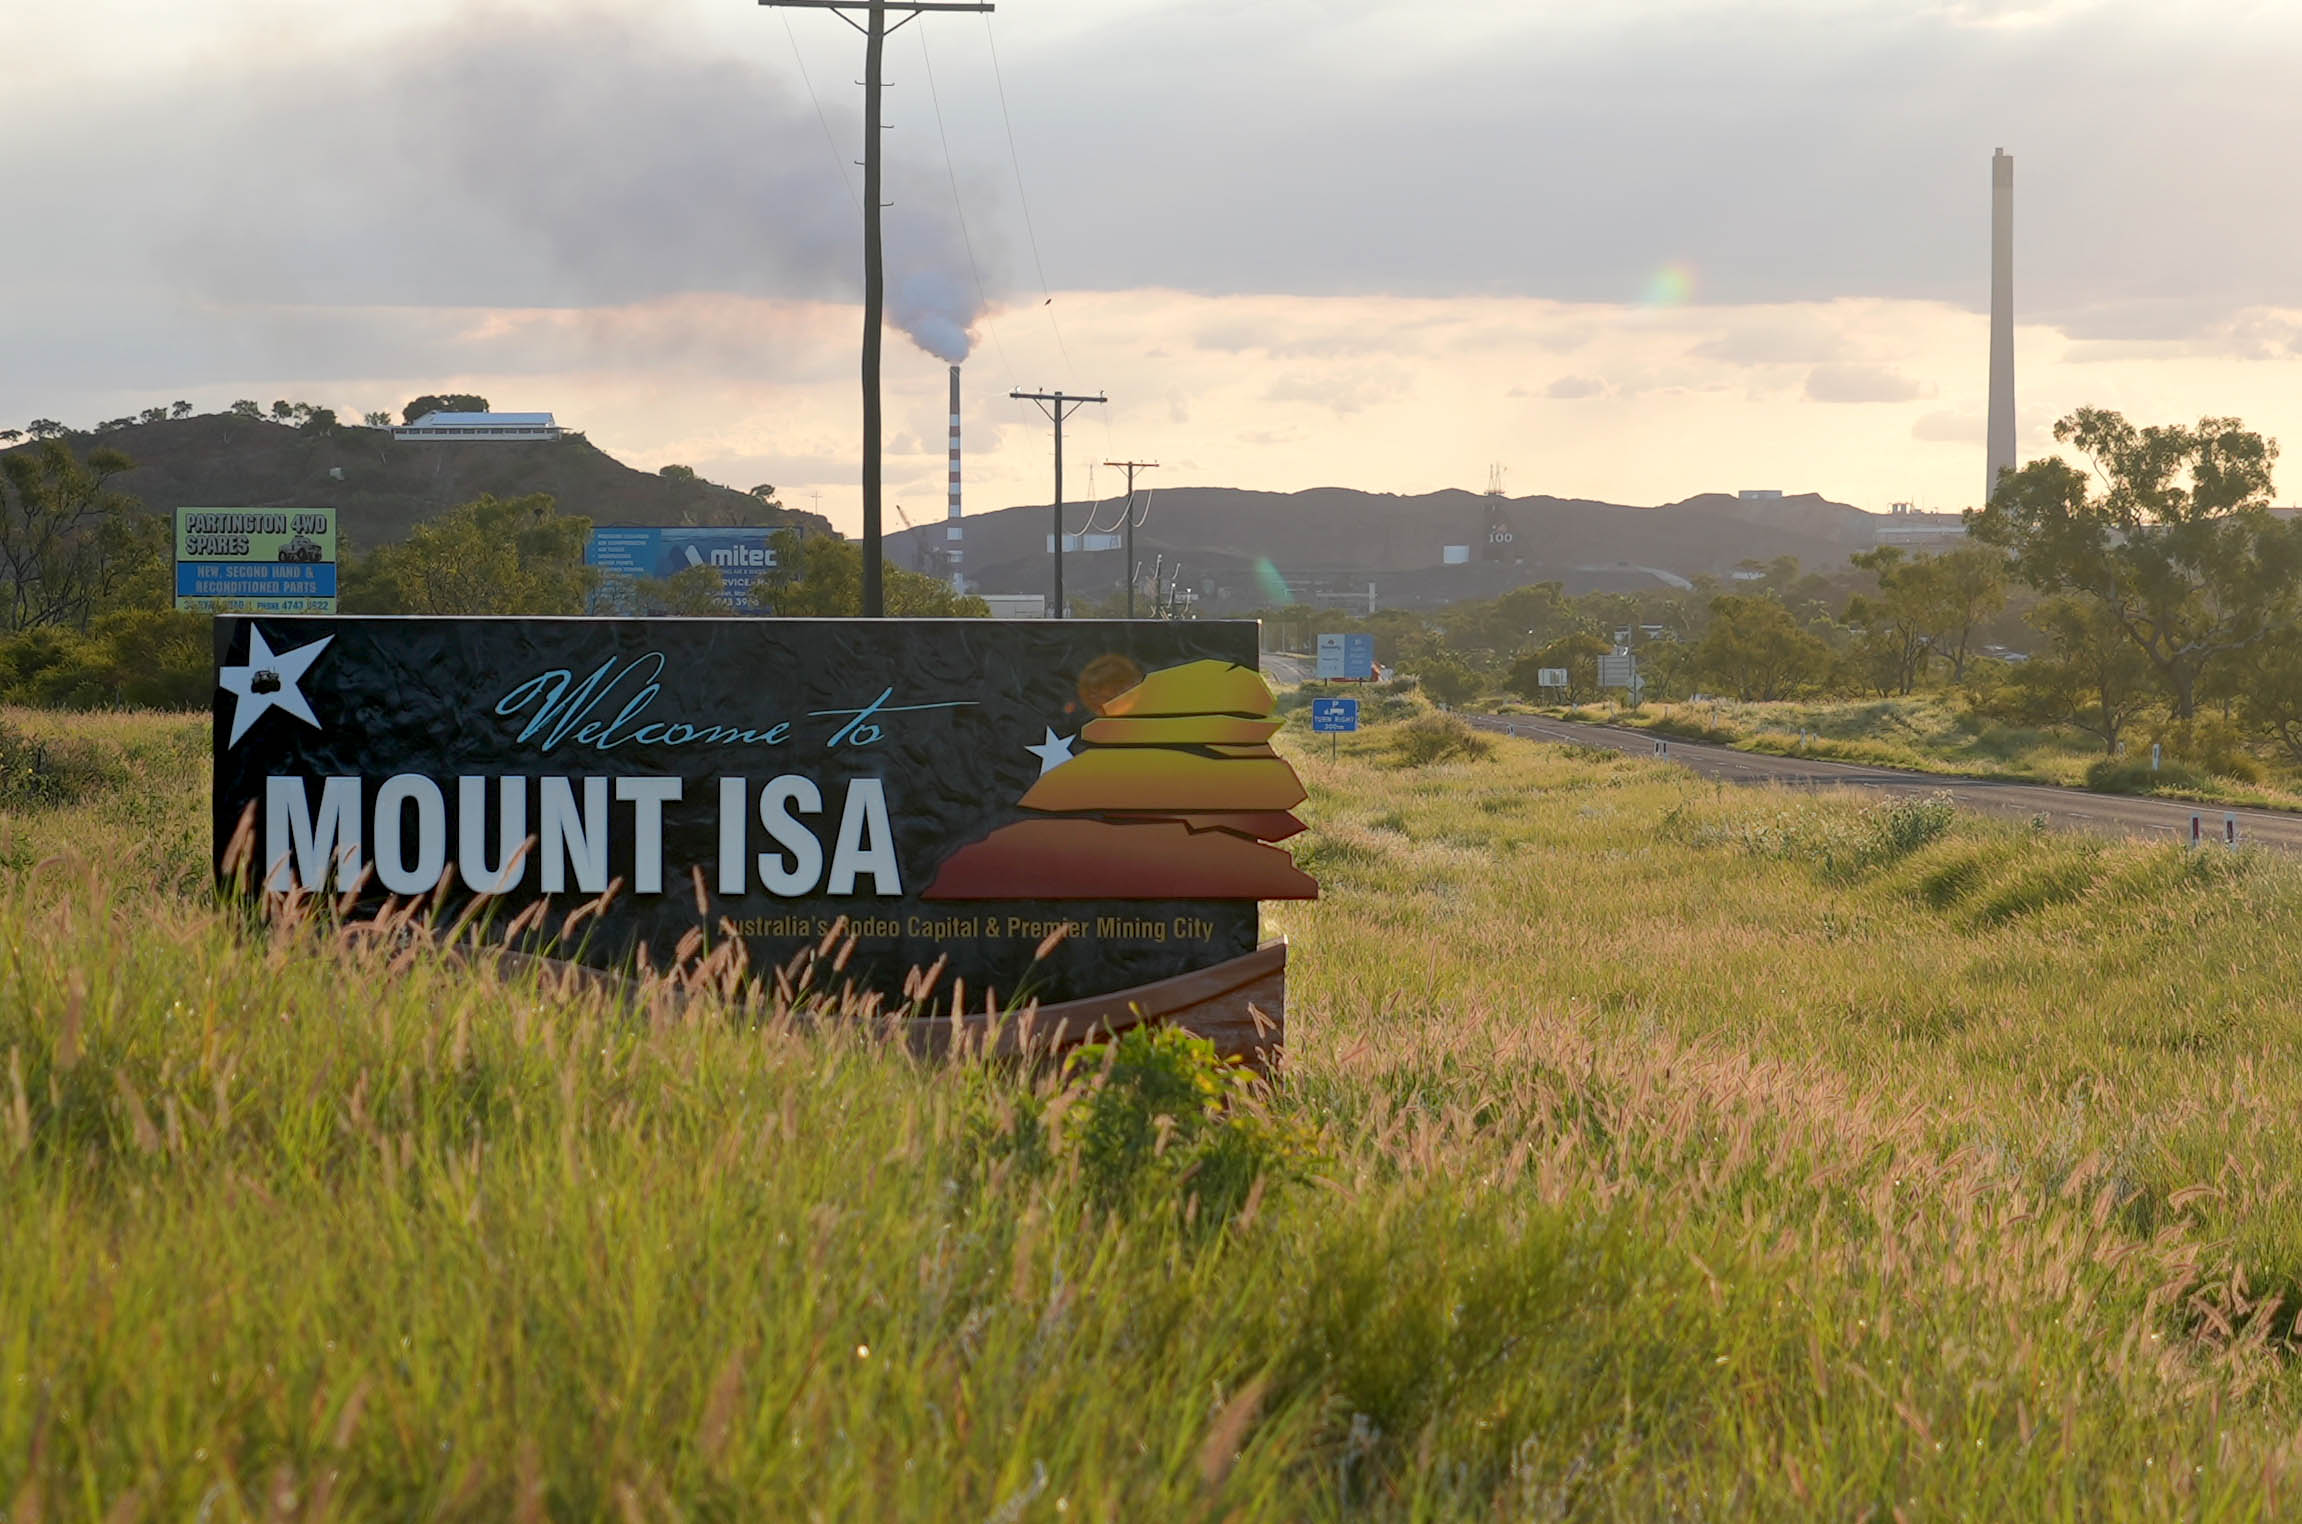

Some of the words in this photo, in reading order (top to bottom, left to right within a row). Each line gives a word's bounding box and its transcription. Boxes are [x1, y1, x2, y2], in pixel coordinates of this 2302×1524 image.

[185, 513, 287, 534] PARTINGTON
[291, 514, 327, 534] 4WD
[185, 535, 249, 555] SPARES
[1490, 531, 1512, 542] 100
[226, 566, 268, 578] SECOND
[272, 566, 299, 578] HAND
[306, 566, 314, 578] &
[195, 581, 280, 593] RECONDITIONED
[284, 581, 317, 593] PARTS
[495, 651, 792, 752] Welcome
[807, 687, 981, 748] to
[265, 774, 683, 897] MOUNT
[718, 774, 903, 897] ISA
[907, 916, 979, 942] Capital
[985, 917, 999, 937] &
[1007, 917, 1089, 938] Premier
[1096, 917, 1166, 942] Mining
[1173, 917, 1213, 942] City
